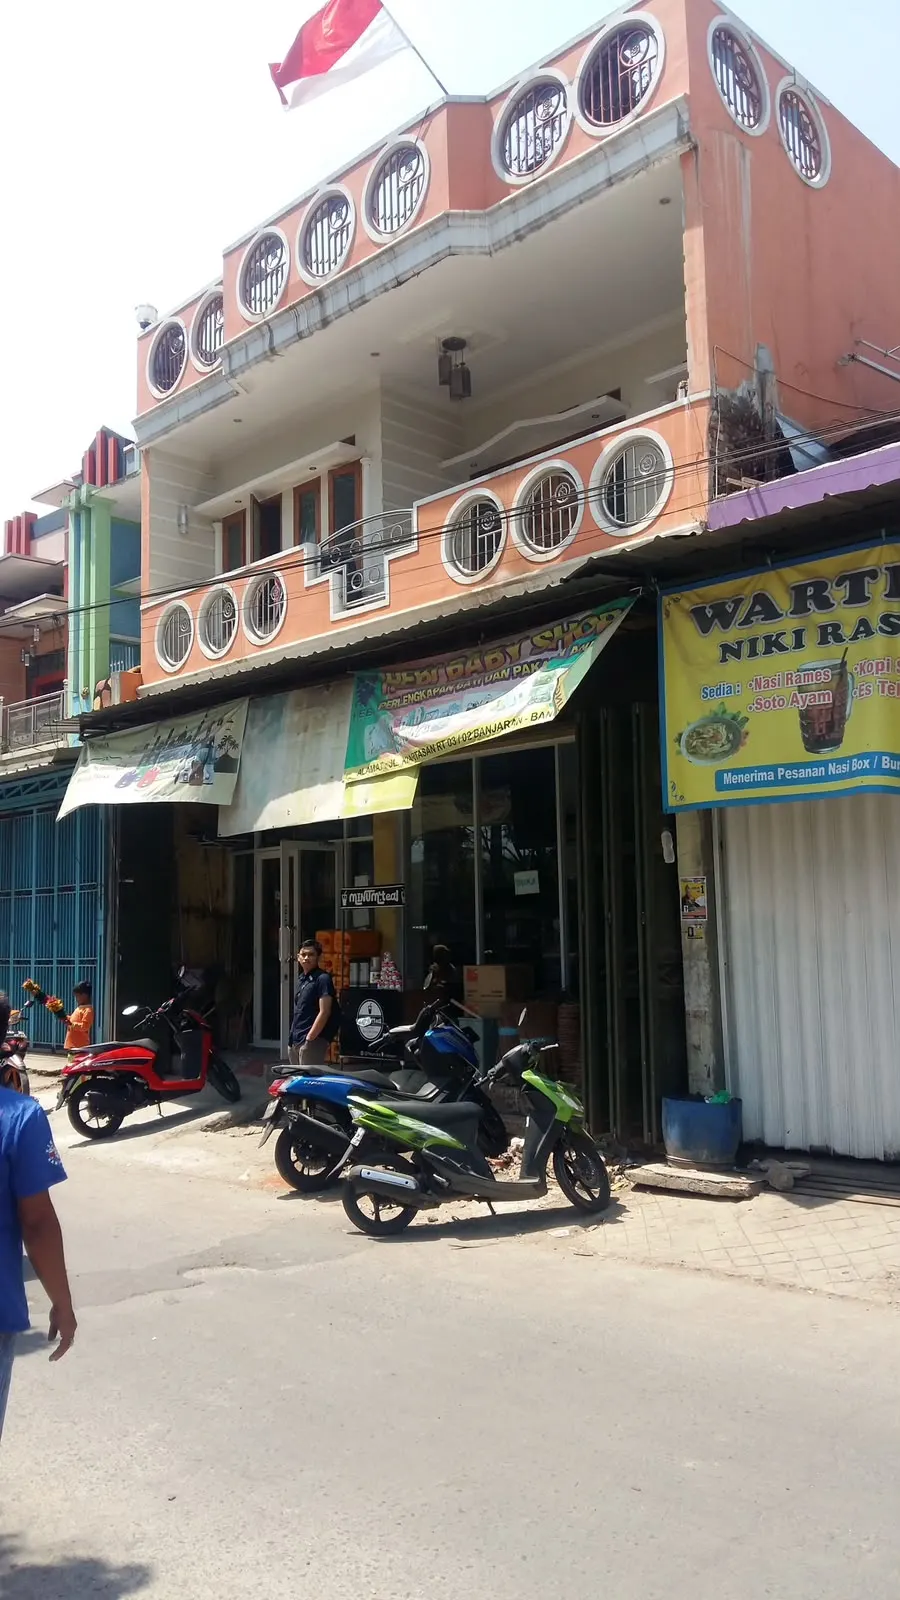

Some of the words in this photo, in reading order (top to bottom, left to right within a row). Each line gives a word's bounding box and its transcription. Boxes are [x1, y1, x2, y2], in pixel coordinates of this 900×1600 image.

[530, 610, 619, 655] SHOP
[719, 627, 807, 664] NIKI
[858, 657, 891, 677] Kopi
[754, 673, 781, 690] Nasi
[785, 669, 831, 686] Rames
[702, 683, 733, 700] Sedia
[754, 697, 786, 712] Soto
[790, 690, 833, 709] Ayam
[858, 682, 873, 699] Es
[436, 739, 448, 753] RT
[448, 735, 456, 747] 03
[462, 732, 473, 743] 02
[723, 769, 775, 785] Menerima
[777, 765, 825, 780] Pesanan
[828, 760, 850, 776] Nasi
[851, 758, 870, 771] Box
